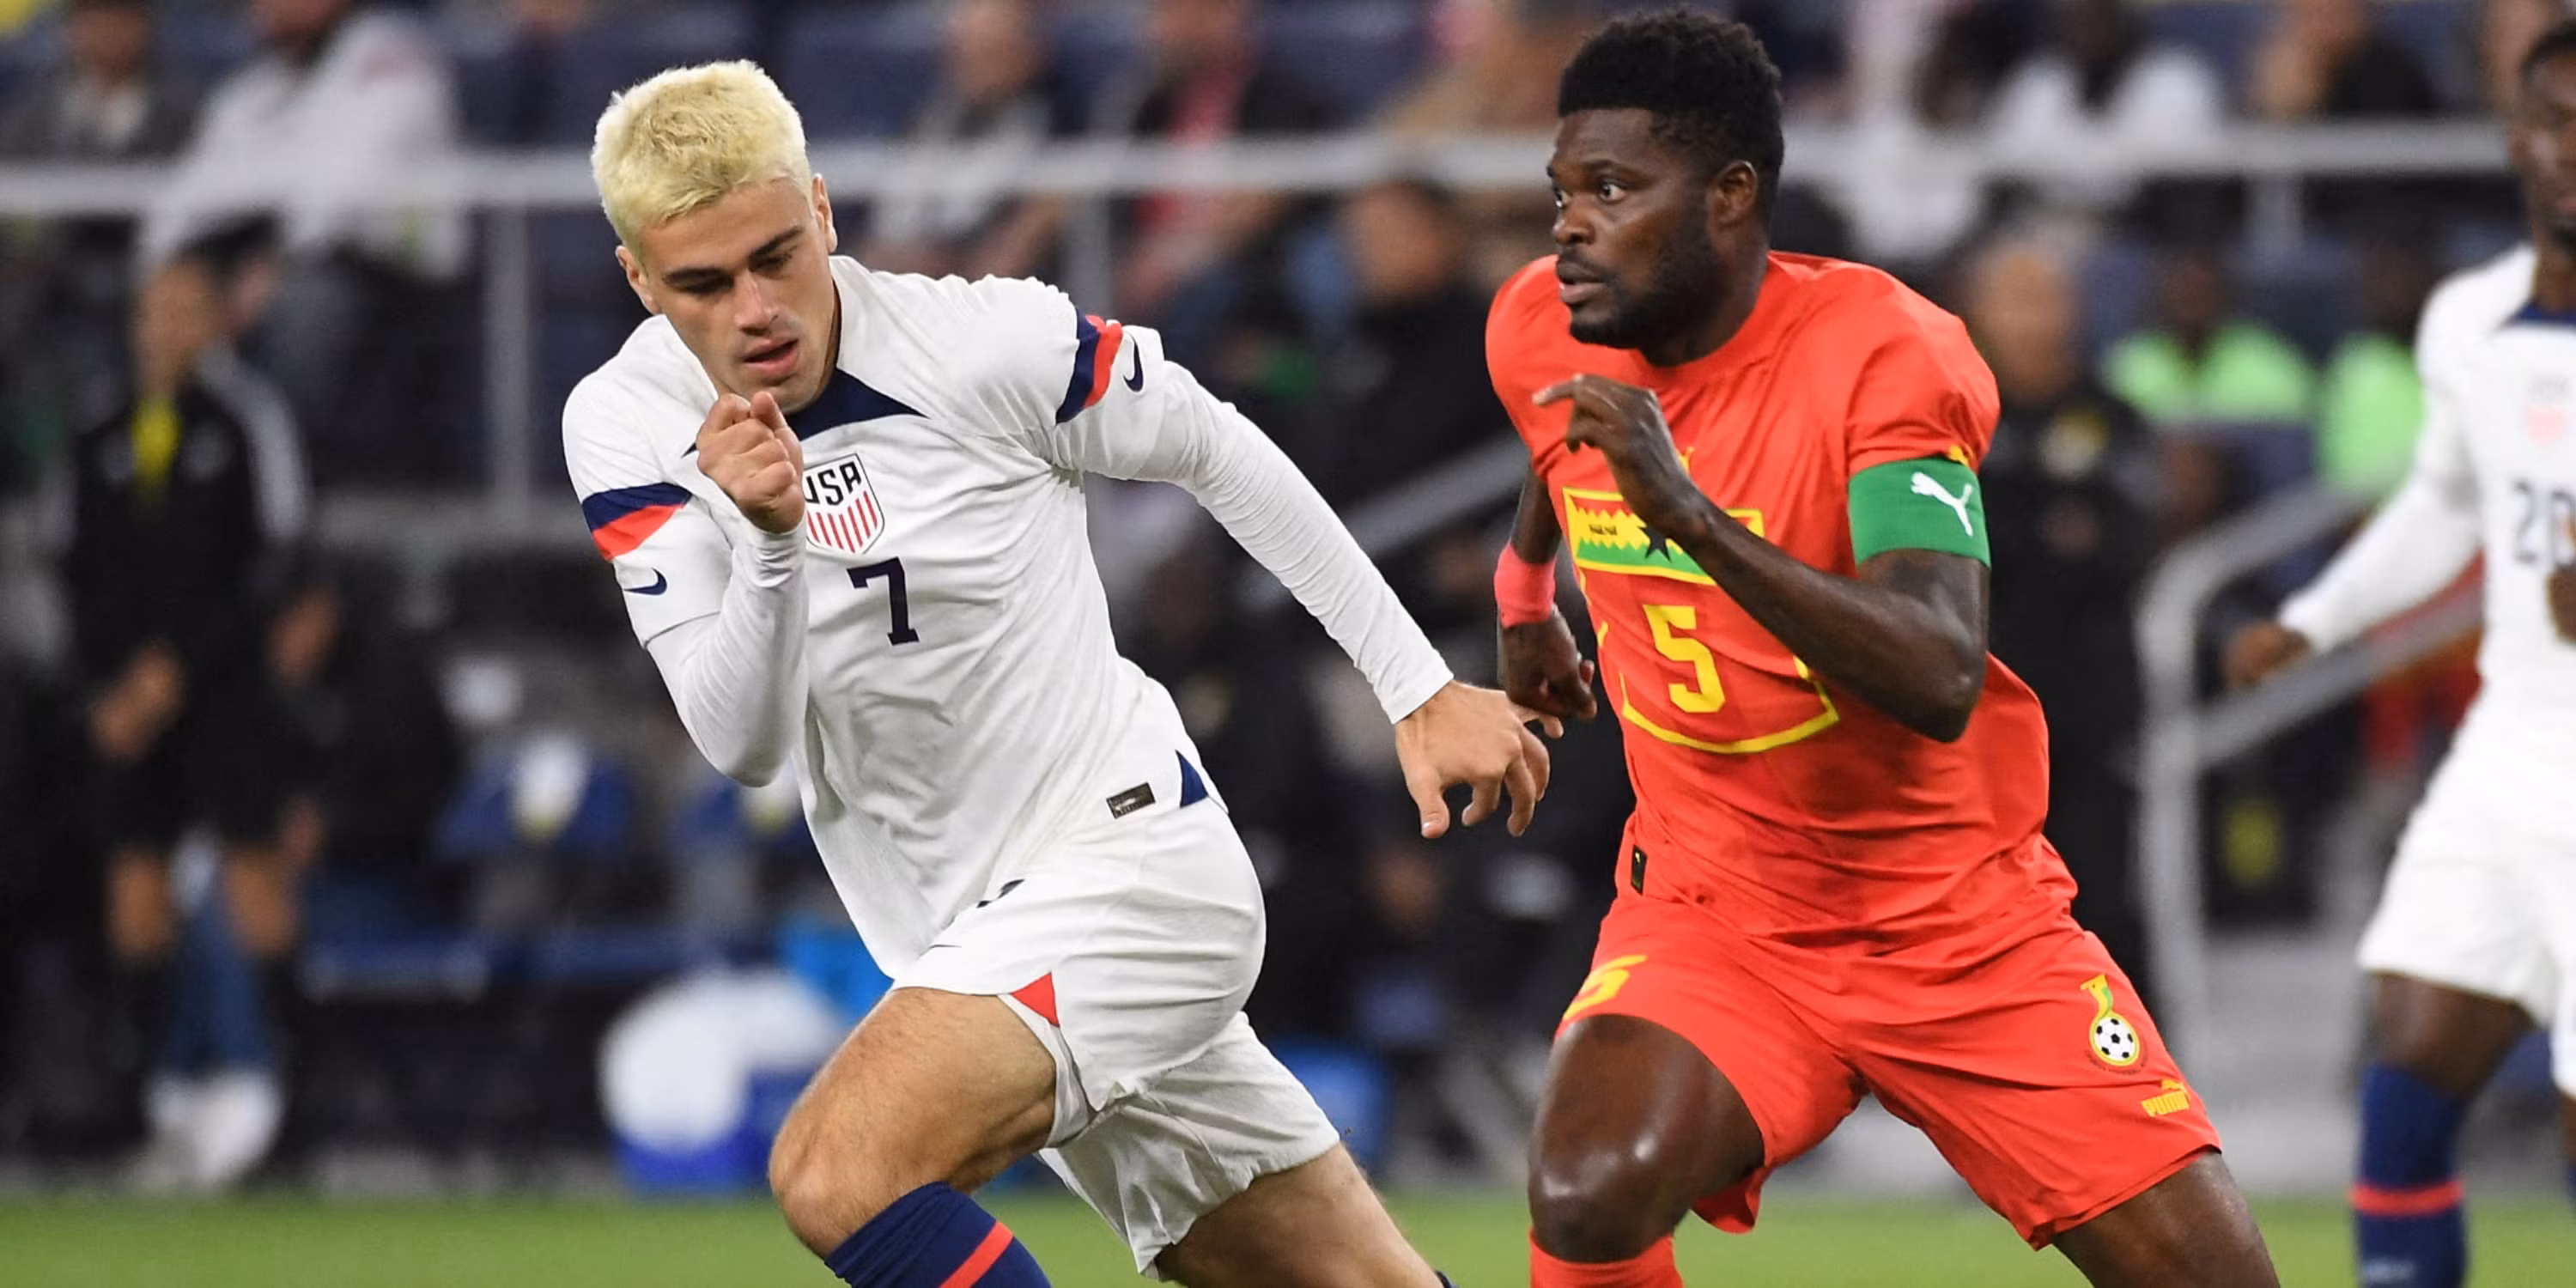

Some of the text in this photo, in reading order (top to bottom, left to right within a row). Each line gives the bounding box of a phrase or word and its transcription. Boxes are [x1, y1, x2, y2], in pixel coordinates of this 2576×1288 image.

[804, 461, 862, 507] USA
[847, 557, 919, 646] 7
[1643, 605, 1726, 713] 5
[2142, 1091, 2190, 1118] PUMA
